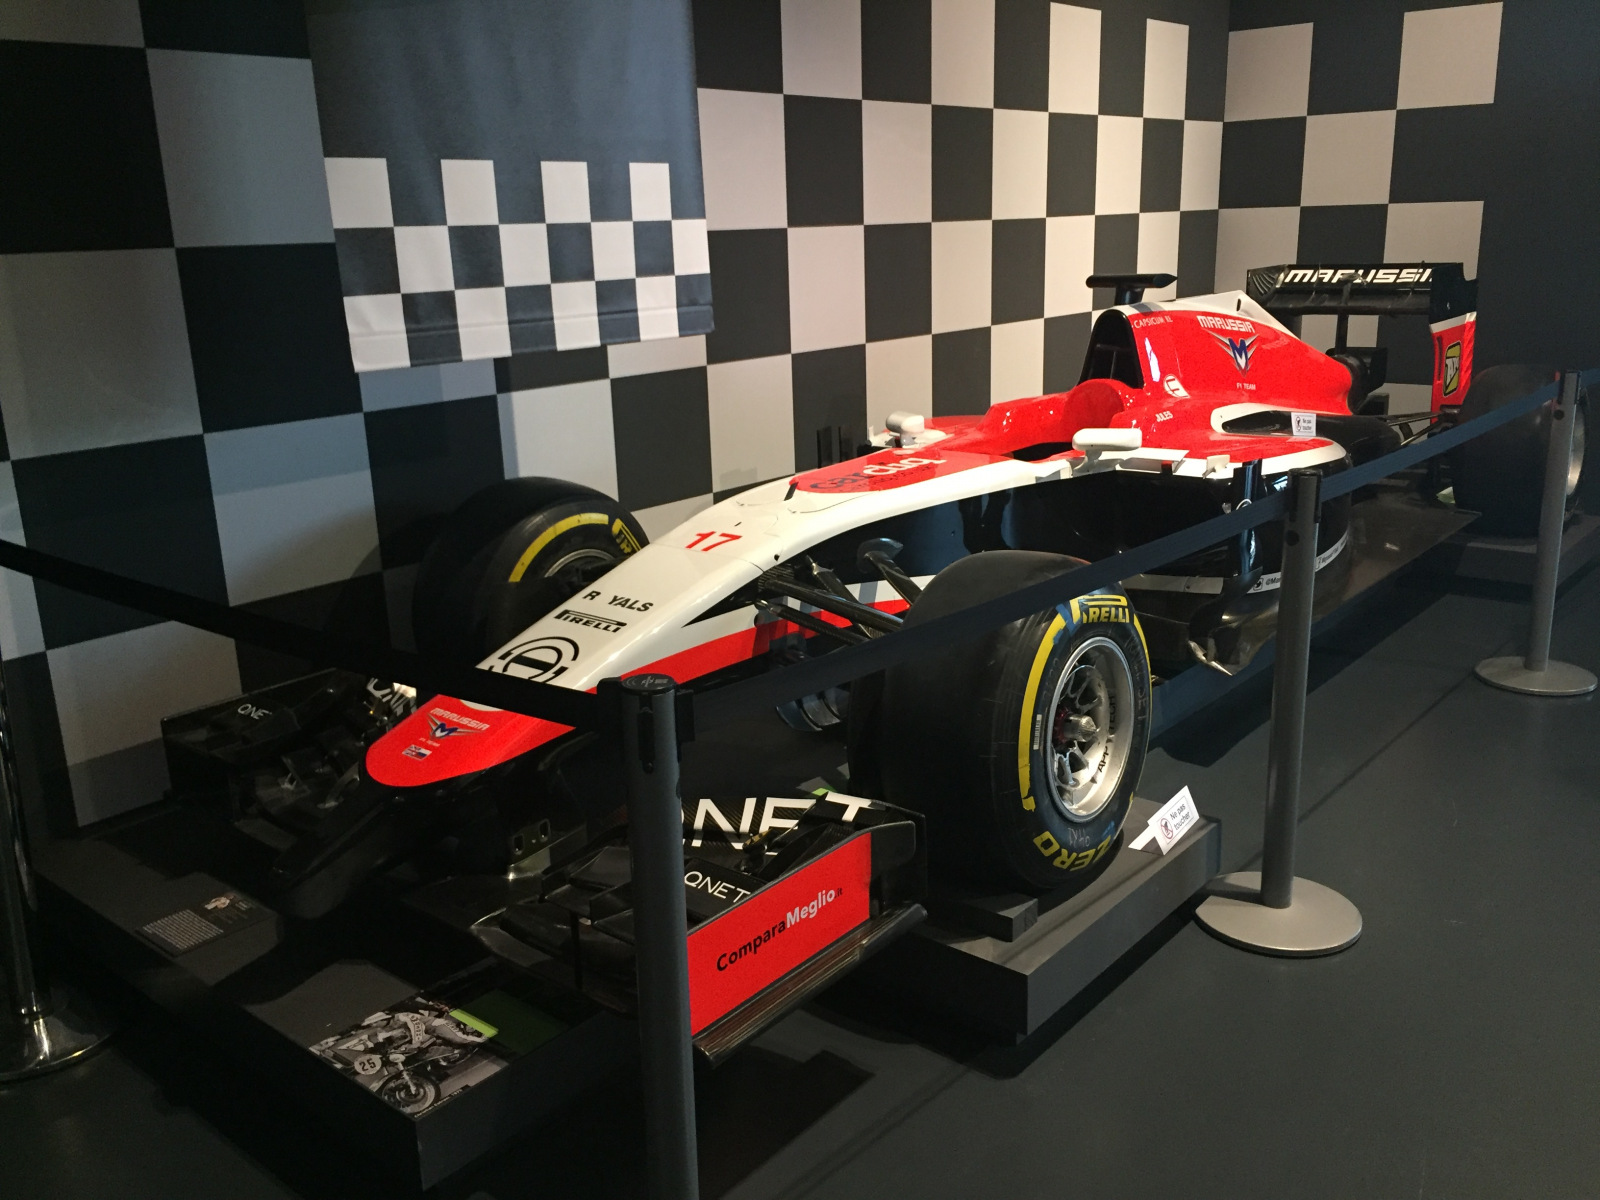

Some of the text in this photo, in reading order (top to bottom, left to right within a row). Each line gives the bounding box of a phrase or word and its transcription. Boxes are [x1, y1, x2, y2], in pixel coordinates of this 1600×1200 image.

[1196, 315, 1256, 333] MARUSSIA
[1155, 410, 1174, 422] JULES
[685, 530, 743, 552] 17
[608, 595, 654, 612] YALS
[553, 609, 628, 633] PIRELLI
[430, 707, 491, 731] MARUSSIA
[1177, 803, 1186, 816] pas
[1174, 811, 1190, 830] toucher
[684, 871, 751, 903] QNET
[716, 888, 843, 971] ComparaMeglio.it
[359, 1058, 377, 1072] 25
